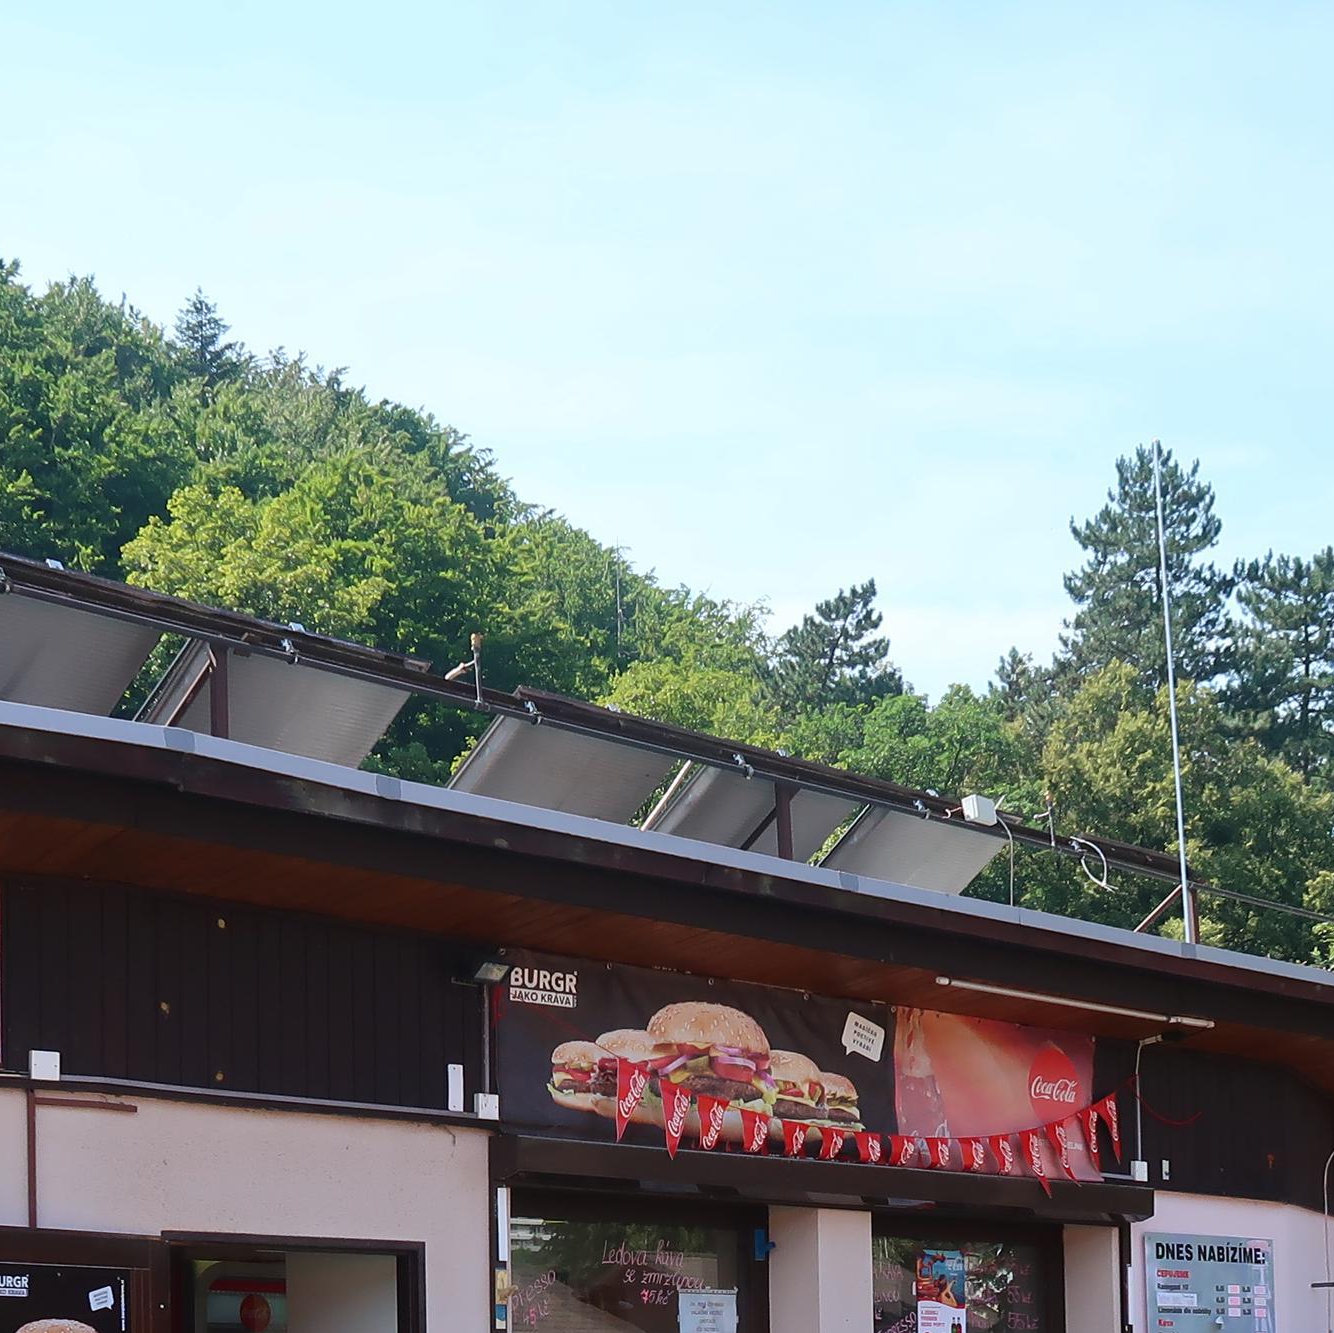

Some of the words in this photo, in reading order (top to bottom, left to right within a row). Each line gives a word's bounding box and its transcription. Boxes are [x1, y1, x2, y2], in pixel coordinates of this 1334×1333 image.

[510, 966, 578, 994] BURGR
[511, 990, 539, 1003] JAKO
[619, 1068, 646, 1119] Coca-Cola
[1031, 1076, 1077, 1103] Coca-Cola
[667, 1087, 691, 1138] Coca-Cola
[702, 1100, 725, 1150] Coca-Cola
[1155, 1242, 1193, 1262] DNES
[1197, 1241, 1266, 1265] NABÍZÍME:
